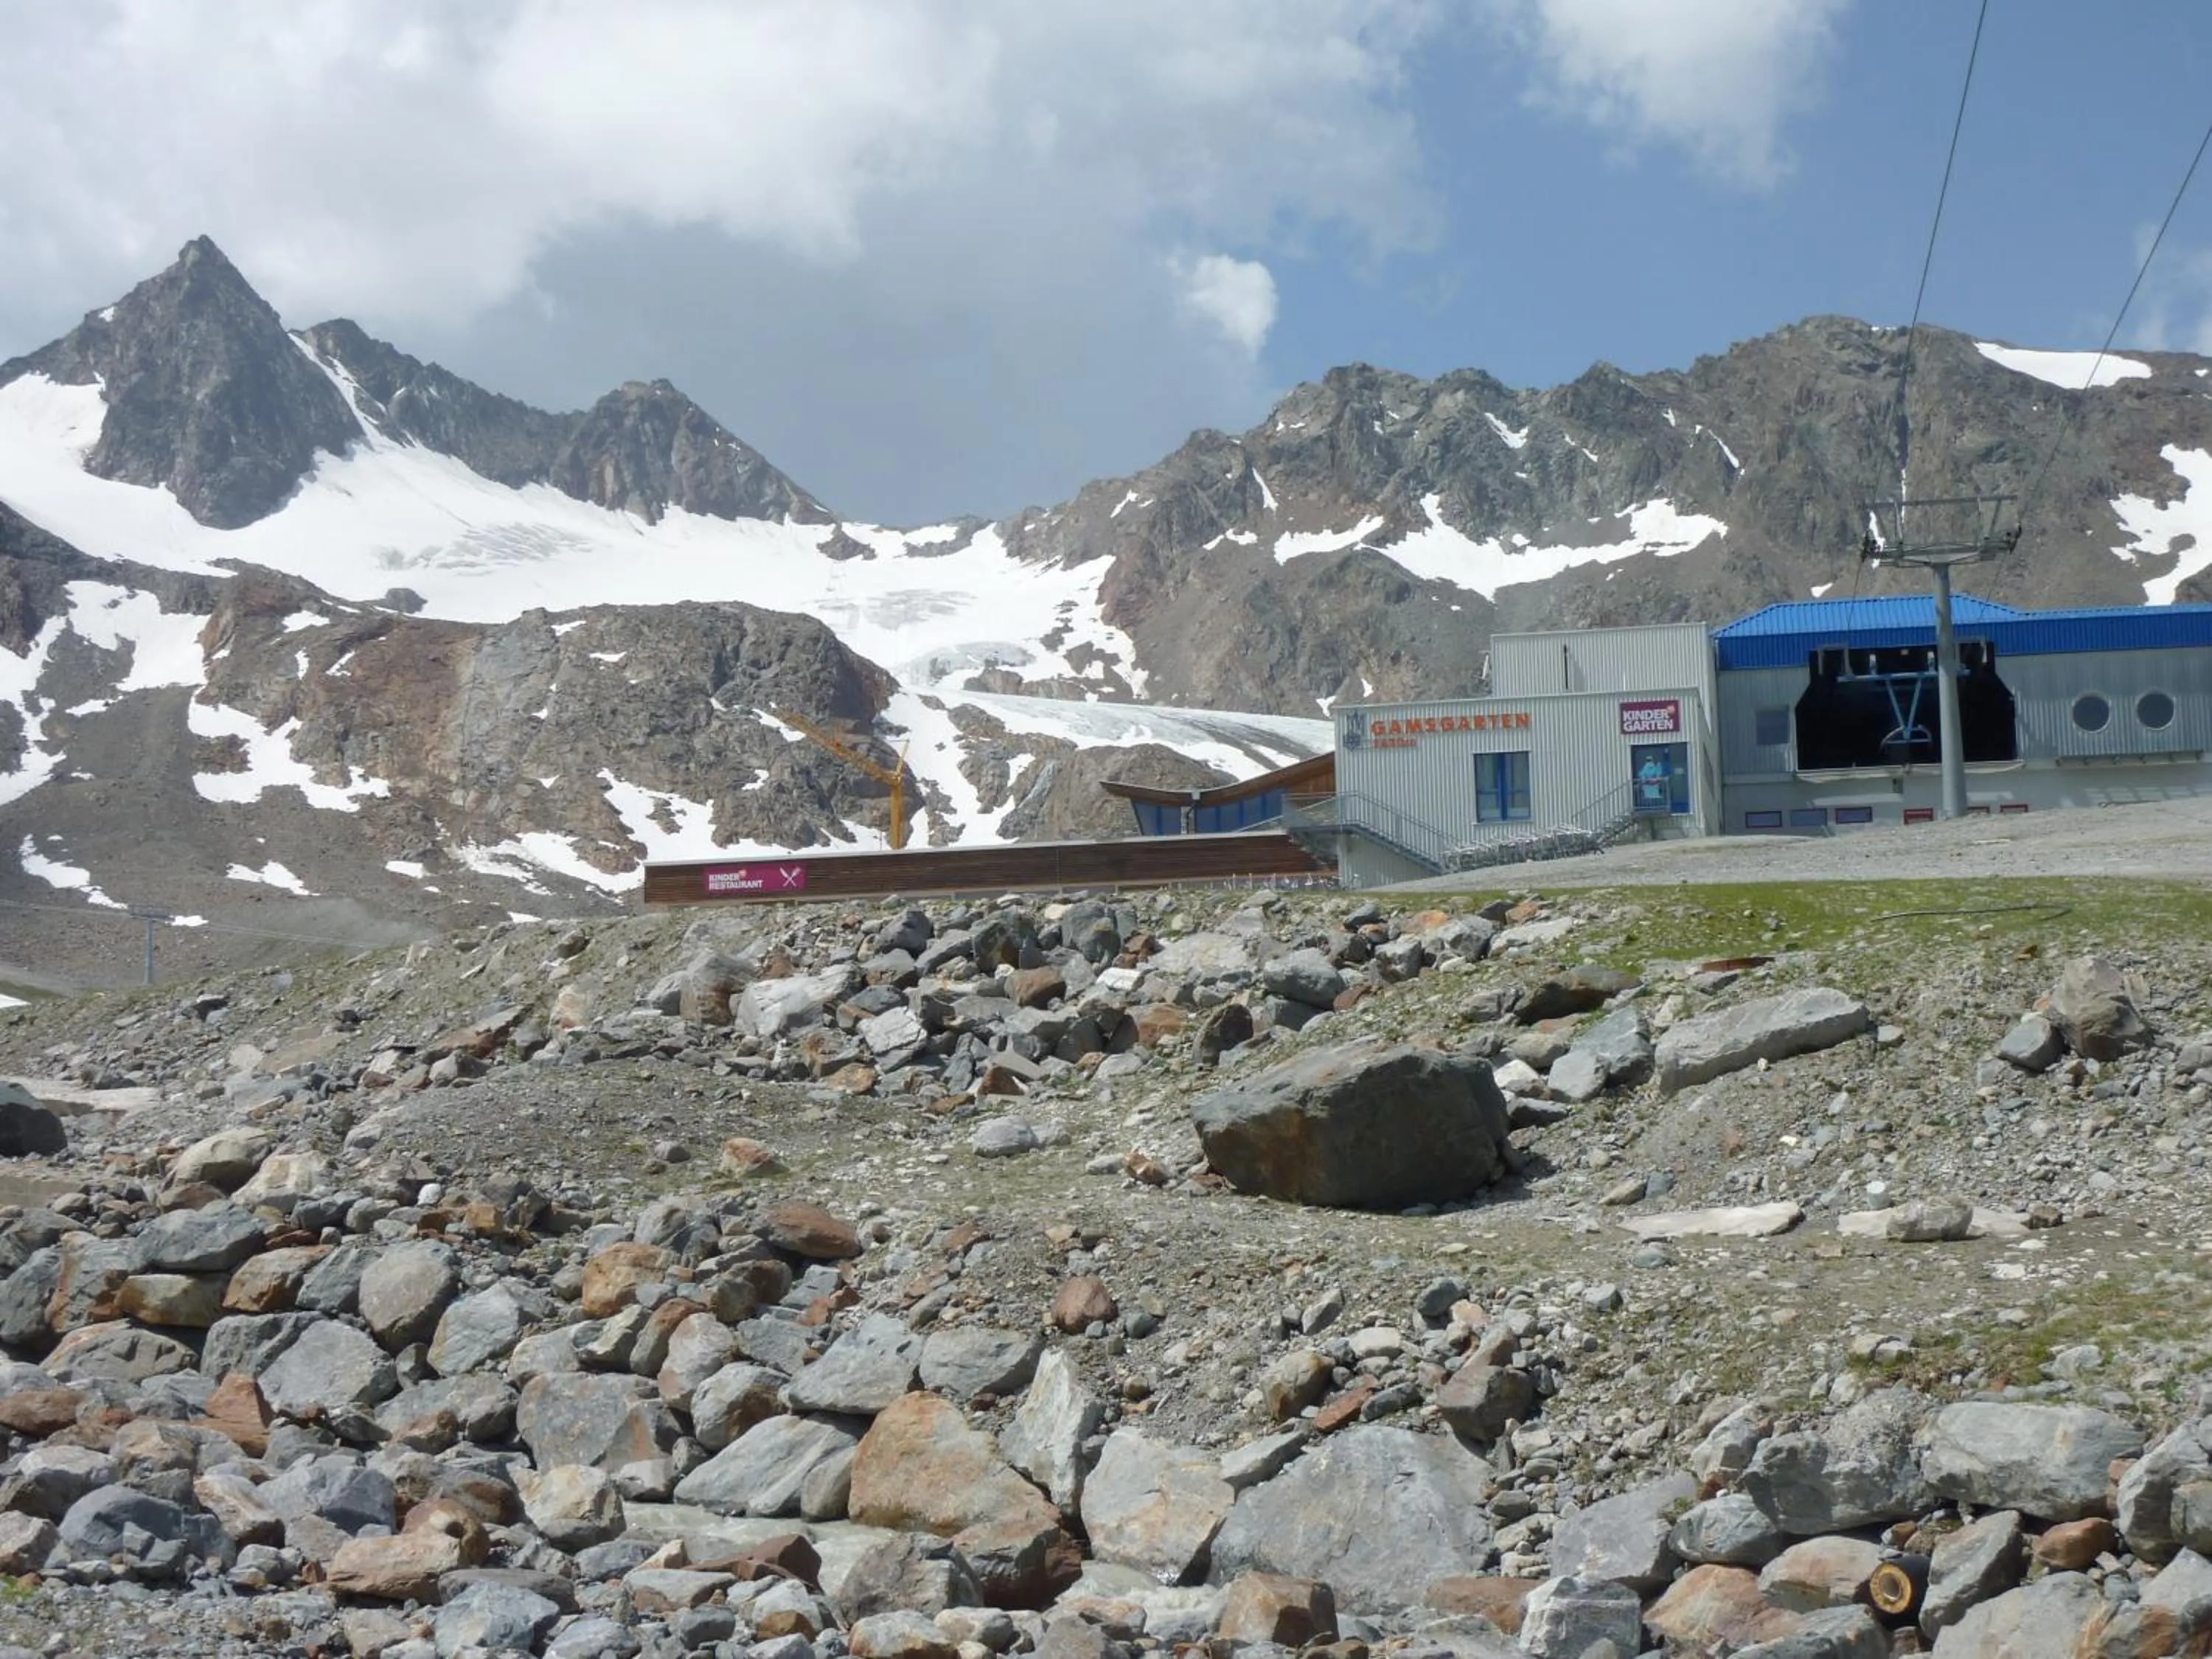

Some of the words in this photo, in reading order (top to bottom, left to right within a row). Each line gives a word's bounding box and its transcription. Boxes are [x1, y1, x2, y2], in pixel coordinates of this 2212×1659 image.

[1623, 709, 1669, 721] KINDER
[1371, 713, 1529, 735] GAMSGARTEN
[1624, 719, 1673, 732] GARTEN
[709, 873, 740, 883] KINDER
[709, 880, 763, 891] RESTAURANT
